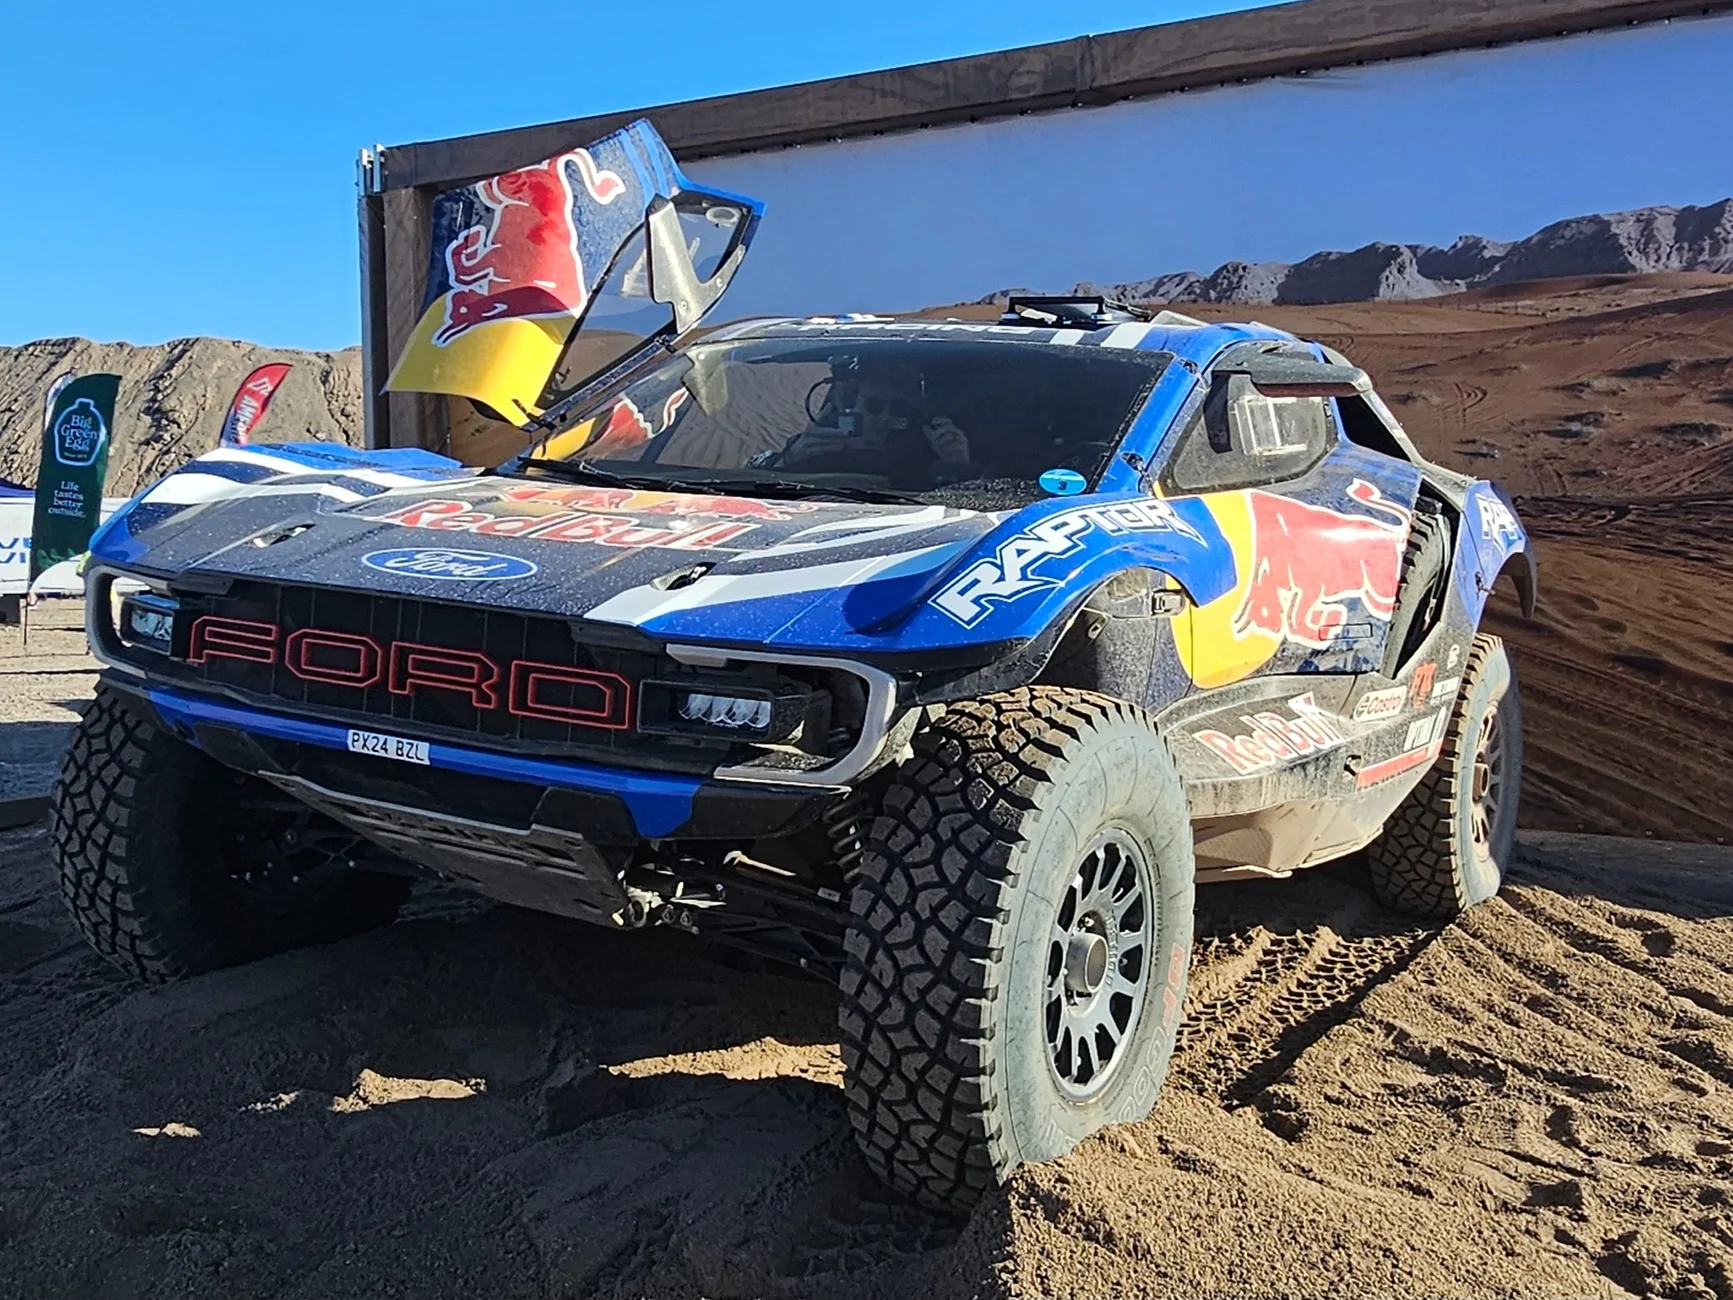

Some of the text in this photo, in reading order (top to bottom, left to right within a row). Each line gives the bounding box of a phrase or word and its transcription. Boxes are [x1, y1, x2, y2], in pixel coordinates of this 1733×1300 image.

[71, 414, 93, 431] Big
[60, 424, 98, 440] Green
[64, 436, 90, 452] Egg
[60, 480, 80, 491] Life
[1057, 480, 1068, 491] 3
[53, 496, 84, 509] better
[54, 489, 84, 501] tastes
[384, 551, 508, 577] Ford
[928, 497, 1208, 630] RAPTOR
[187, 615, 632, 730] FORD
[351, 731, 425, 762] PX24 BZL
